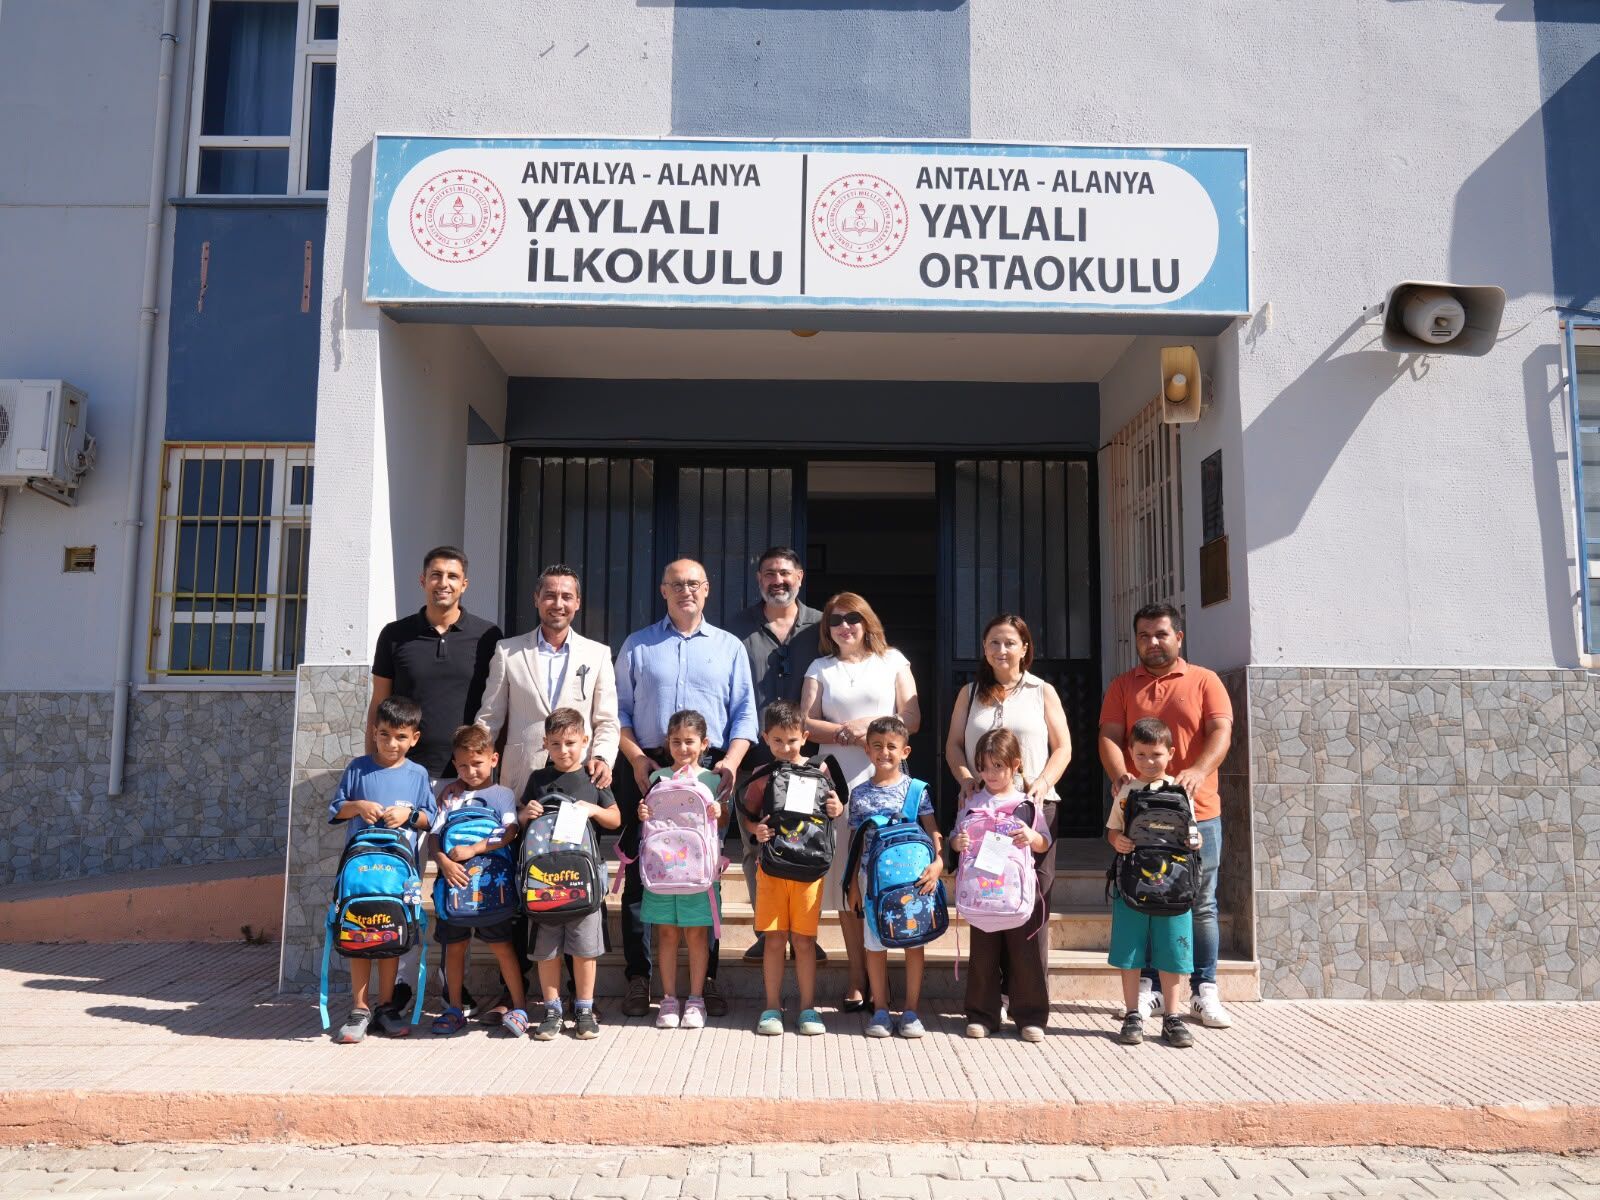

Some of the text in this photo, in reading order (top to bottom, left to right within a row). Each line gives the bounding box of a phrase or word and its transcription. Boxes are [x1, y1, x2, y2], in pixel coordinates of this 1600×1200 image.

[522, 161, 636, 185] ANTALYA
[657, 162, 761, 187] ALANYA
[916, 166, 1030, 192] ANTALYA
[1052, 169, 1155, 195] ALANYA
[518, 198, 720, 235] YAYLALI
[919, 203, 1087, 242] YAYLALI
[527, 239, 783, 286] İLKOKULU
[919, 252, 1180, 294] ORTAOKULU
[543, 869, 580, 882] traffic
[357, 913, 391, 925] traffic
